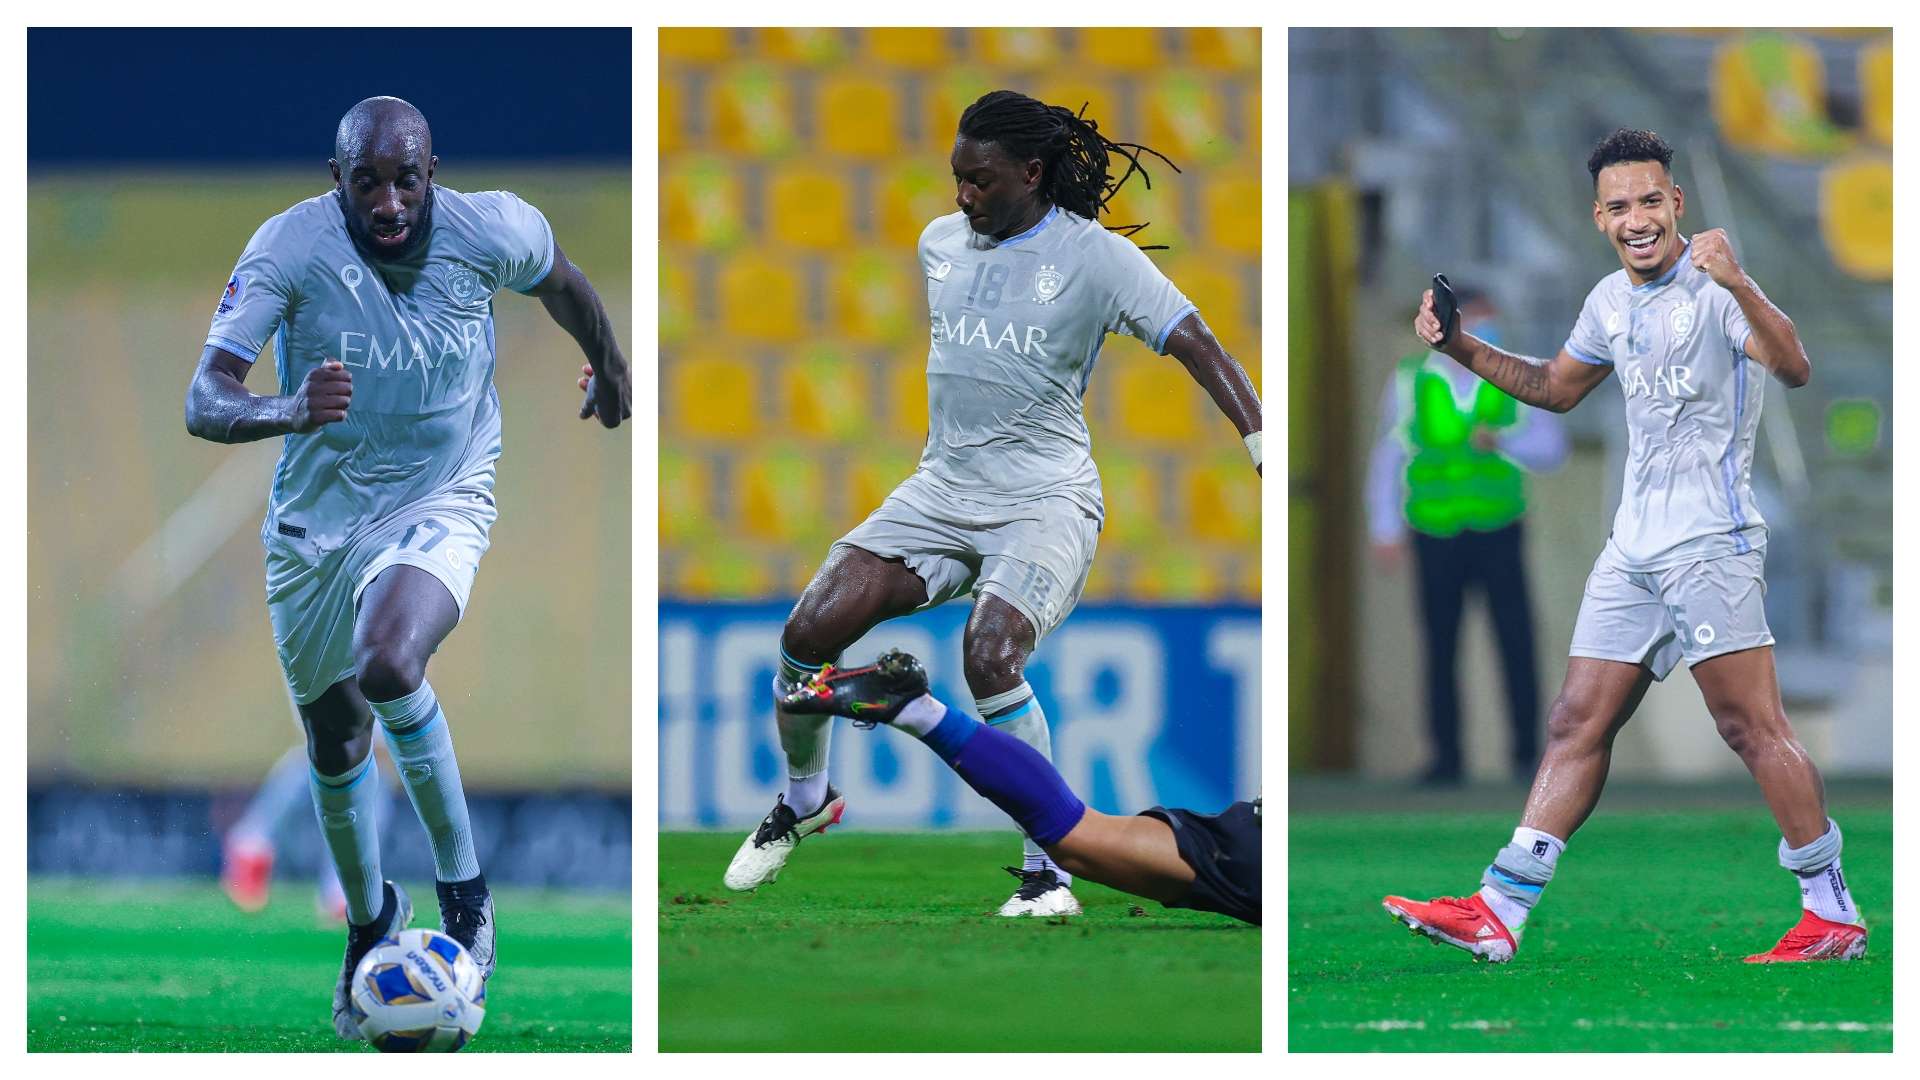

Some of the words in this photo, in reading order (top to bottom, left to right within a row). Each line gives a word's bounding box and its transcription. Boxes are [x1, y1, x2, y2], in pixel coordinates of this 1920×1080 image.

[967, 261, 1010, 310] 18
[339, 320, 482, 371] EMAAR
[397, 518, 450, 554] 17
